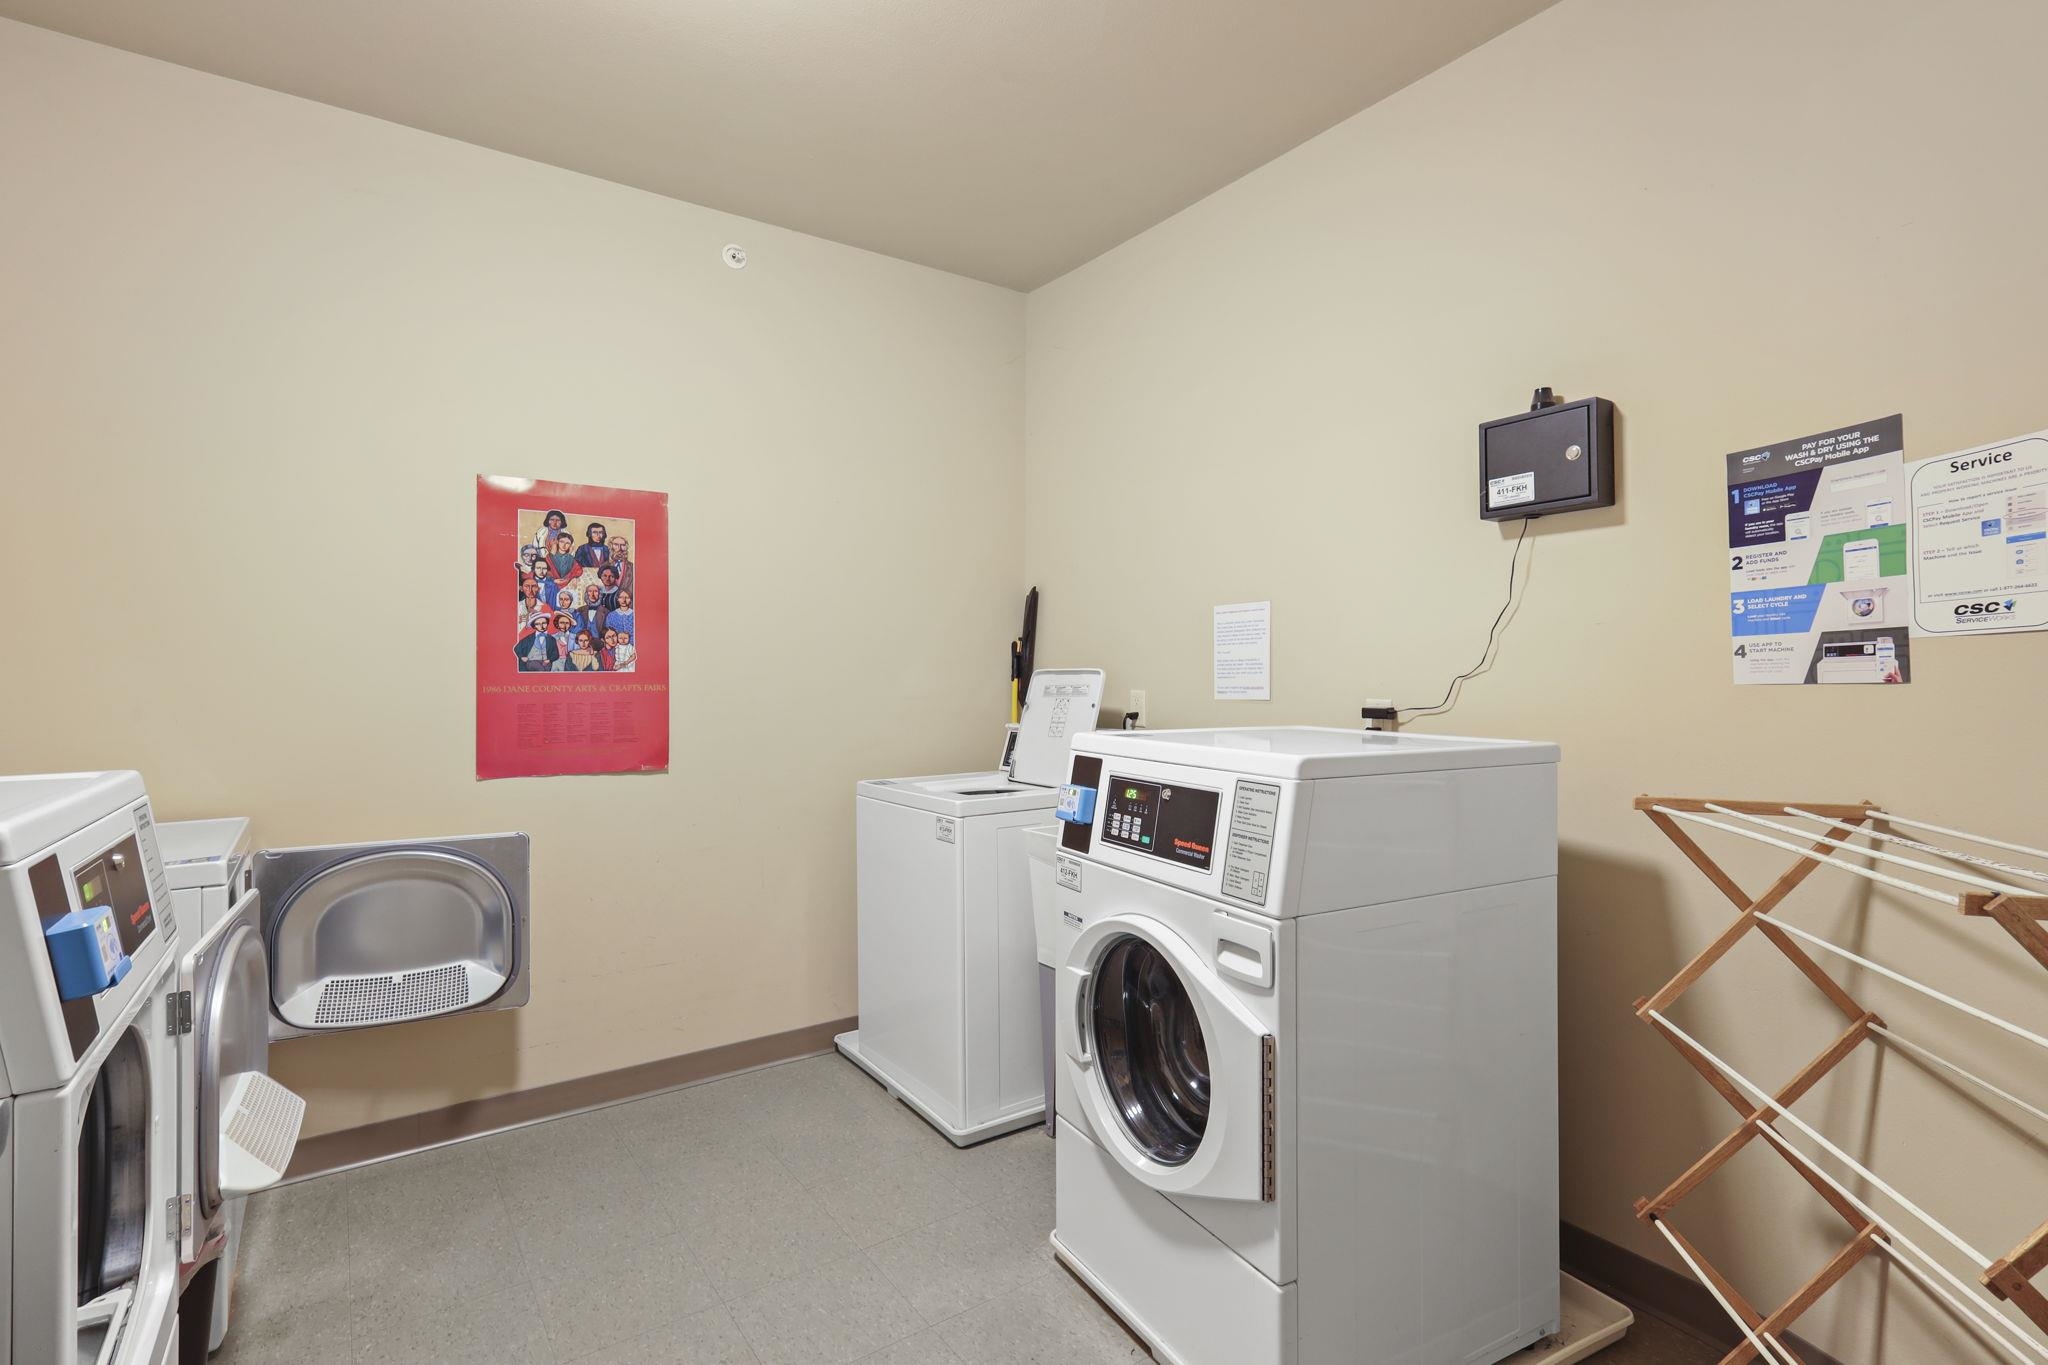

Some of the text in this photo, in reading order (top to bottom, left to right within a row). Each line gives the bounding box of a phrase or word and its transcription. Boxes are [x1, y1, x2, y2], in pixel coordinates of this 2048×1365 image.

[1785, 434, 1880, 462] WASH & DRY USING THE
[1802, 432, 1861, 450] PAY FOR YOUR
[1742, 454, 1762, 464] CSC
[1794, 446, 1870, 467] CSCPay Mobile App
[1950, 451, 2012, 474] Service
[1497, 484, 1527, 495] 411-FKH
[1743, 482, 1778, 493] DOWNLOAD
[1731, 489, 1740, 504] 1
[1732, 556, 1743, 570] 2
[1732, 600, 1745, 614] 3
[1954, 601, 2000, 616] CSC
[1734, 644, 1747, 658] 4
[532, 685, 572, 693] COUNTY
[575, 684, 597, 692] ARTS
[608, 684, 642, 692] CRAFTS
[1174, 838, 1209, 853] Speed Queen
